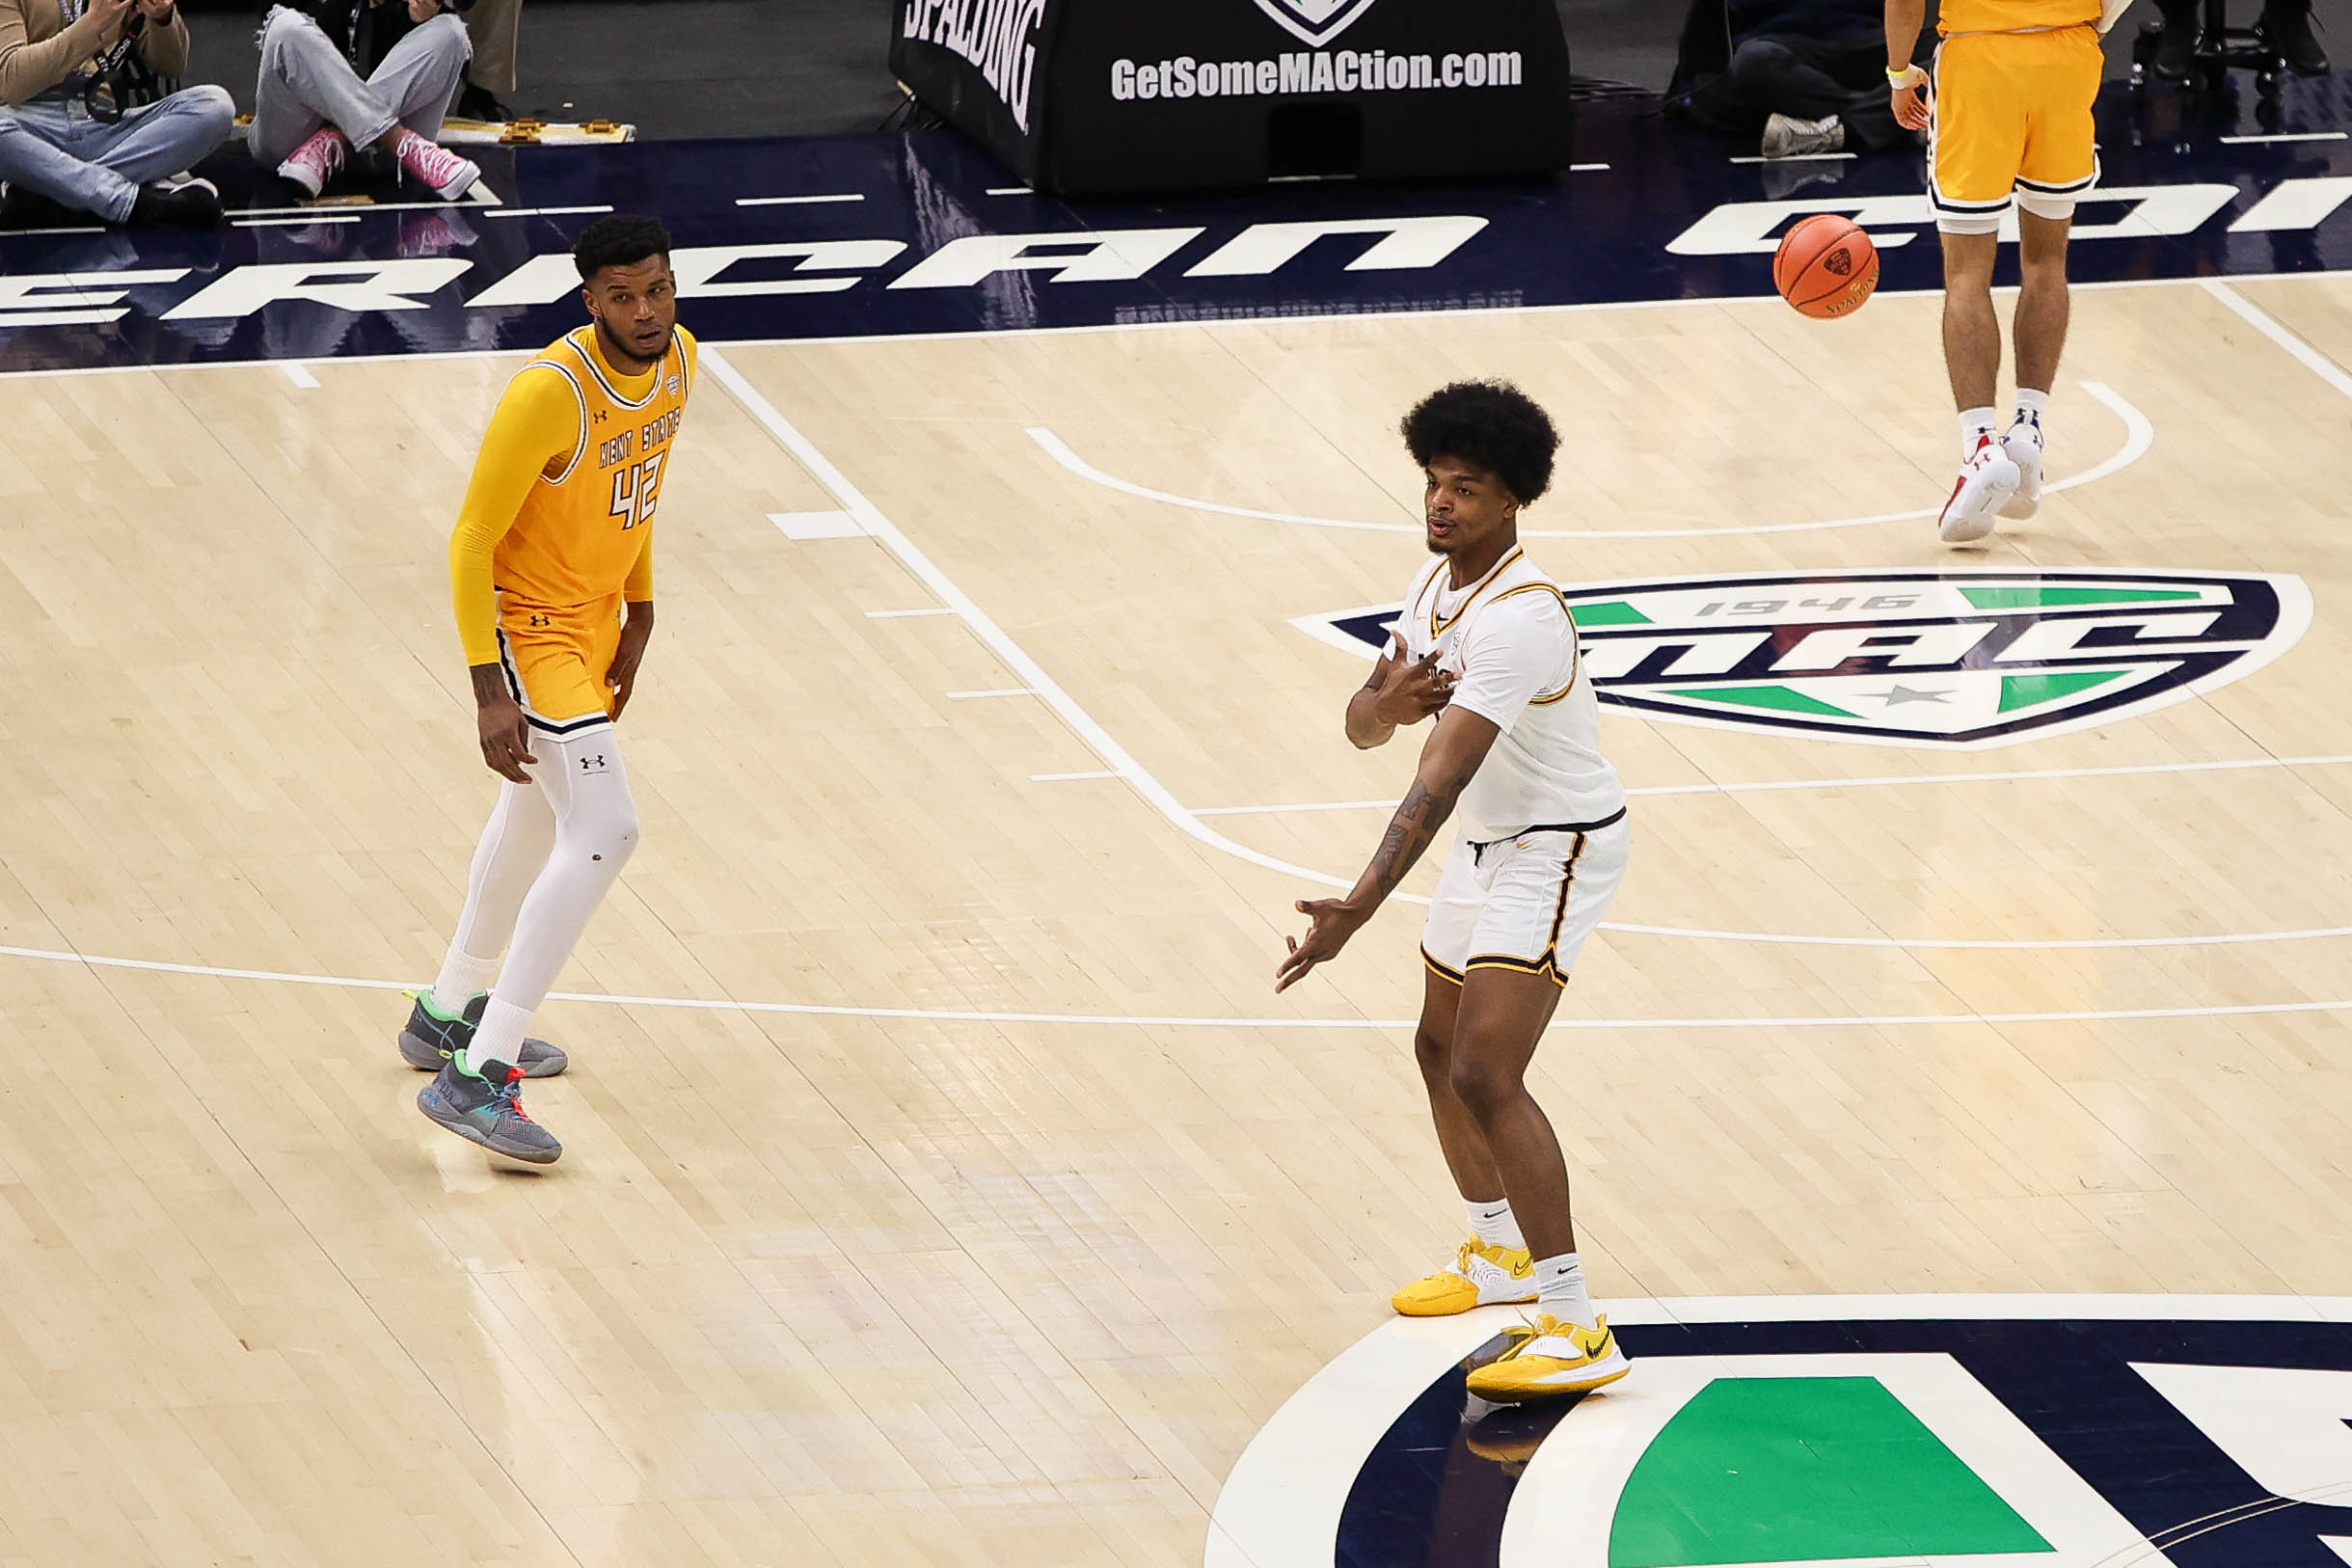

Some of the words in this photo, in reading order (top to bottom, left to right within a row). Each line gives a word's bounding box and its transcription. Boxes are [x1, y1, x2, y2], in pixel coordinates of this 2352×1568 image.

[1111, 50, 1523, 100] GetSomeMACtion.com
[598, 429, 633, 470] KENT
[608, 448, 666, 530] 42
[1694, 594, 1922, 617] 1946
